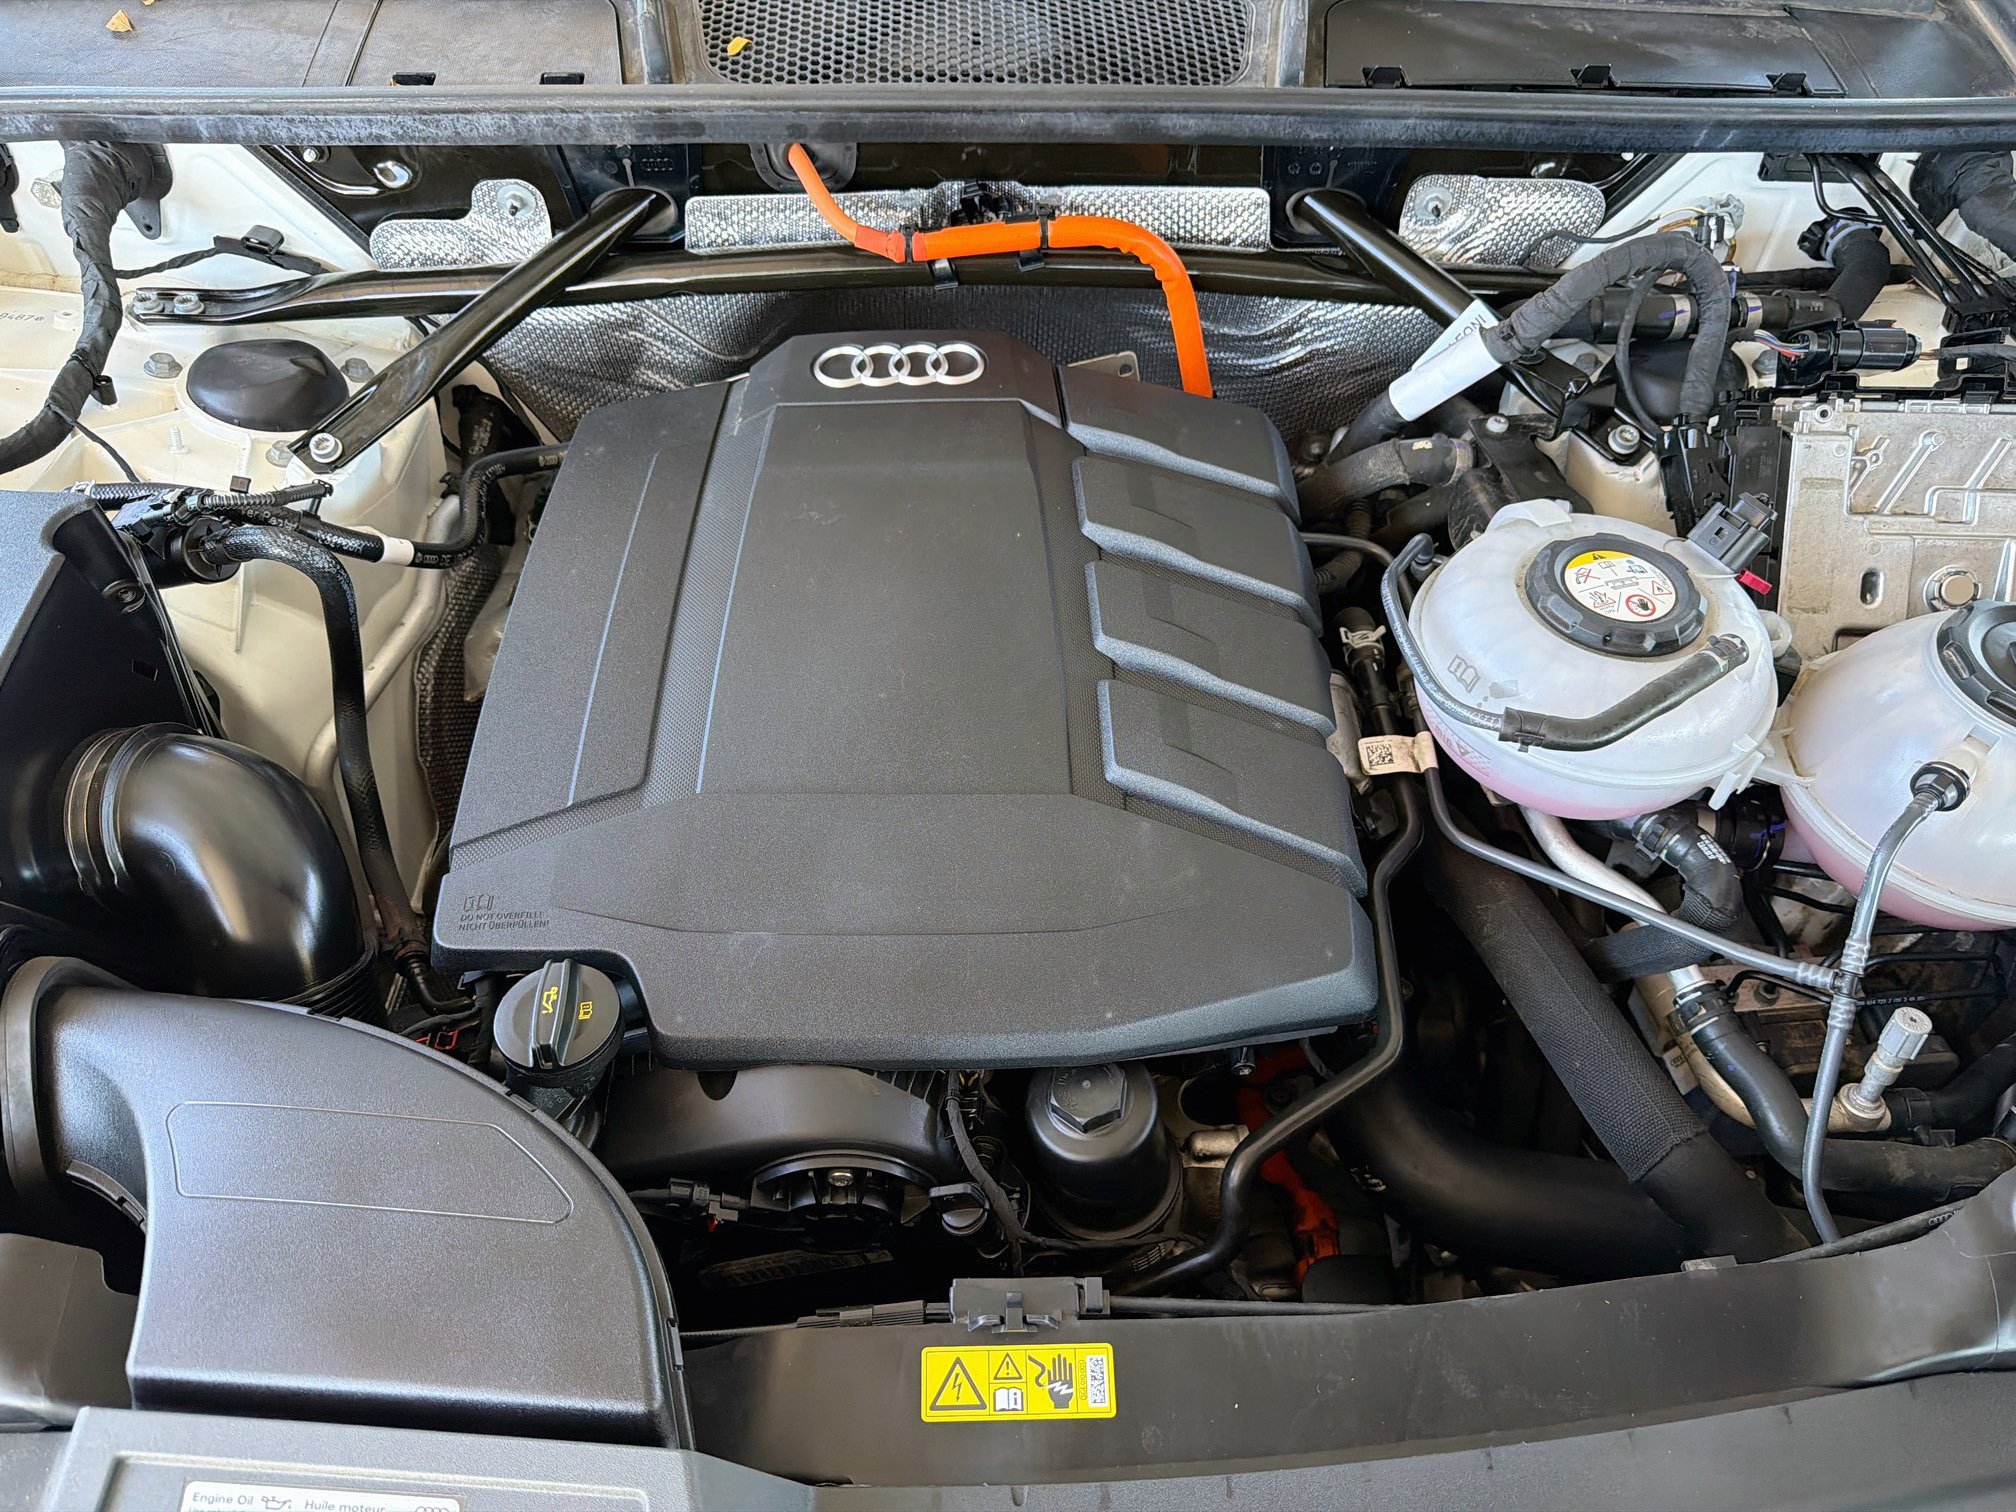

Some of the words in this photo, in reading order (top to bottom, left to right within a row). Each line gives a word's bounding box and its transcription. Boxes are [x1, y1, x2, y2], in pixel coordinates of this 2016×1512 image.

[460, 914, 474, 922] DO
[458, 922, 487, 931] NICHT
[192, 1491, 234, 1505] Engine
[237, 1494, 255, 1506] Oil
[304, 1499, 336, 1511] Huile
